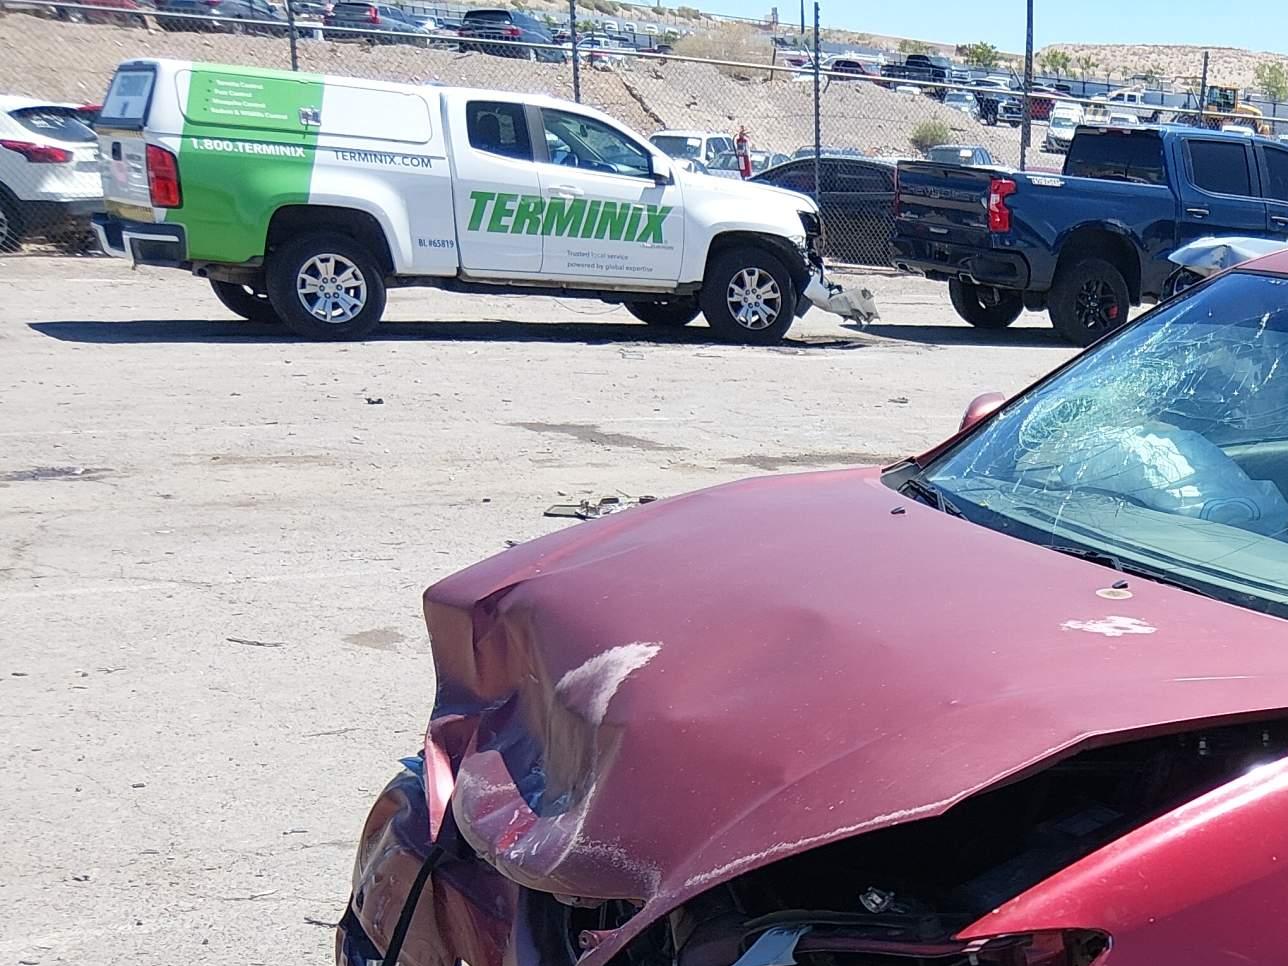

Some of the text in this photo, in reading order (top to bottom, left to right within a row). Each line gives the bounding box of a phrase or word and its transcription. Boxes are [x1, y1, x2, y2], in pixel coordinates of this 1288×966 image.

[191, 137, 306, 158] 1.800.TERMINIX
[334, 150, 433, 168] TERMINIX.COM
[467, 190, 674, 244] TERMINIX
[429, 239, 454, 249] #65819
